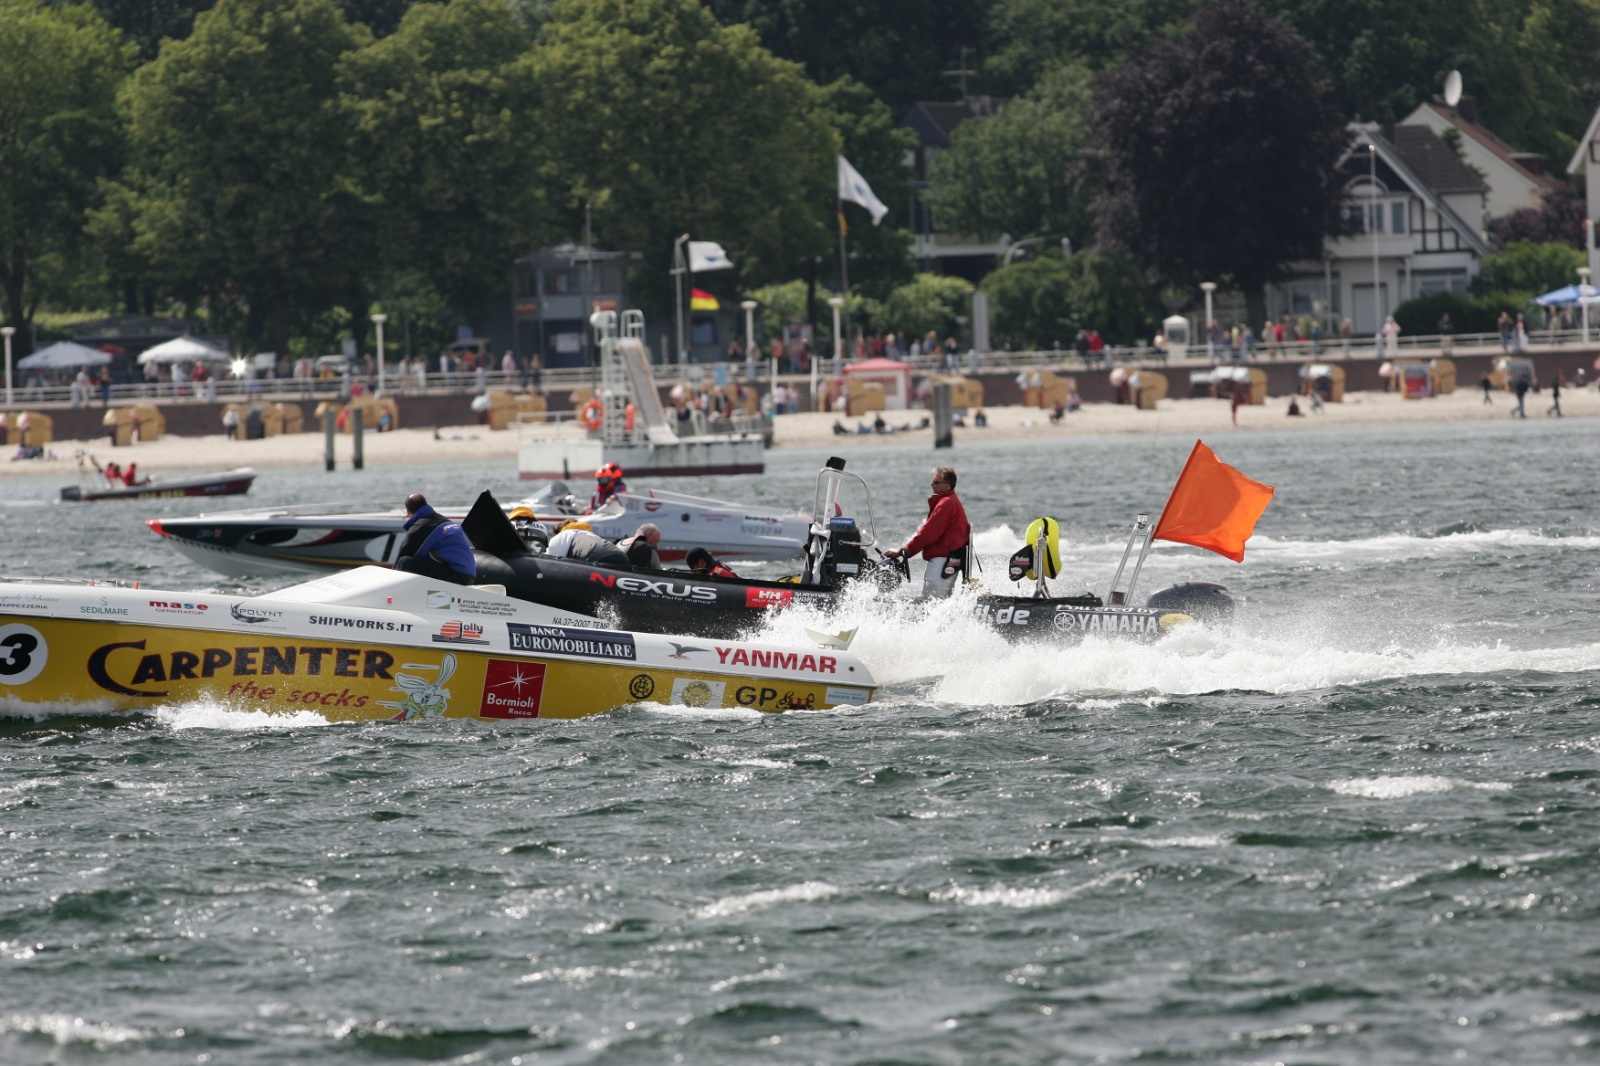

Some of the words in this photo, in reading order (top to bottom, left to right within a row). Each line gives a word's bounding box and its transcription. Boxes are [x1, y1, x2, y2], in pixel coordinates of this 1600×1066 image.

[588, 571, 718, 601] NEXUS
[80, 605, 129, 616] SEDILMARE
[148, 600, 209, 611] mase
[155, 608, 204, 616] GENERATOR
[239, 607, 284, 618] POLYNT
[1055, 604, 1134, 613] Powered
[1137, 606, 1160, 616] by
[308, 615, 414, 633] SHIPWORKS.IT
[529, 626, 566, 638] BANCA
[1077, 613, 1159, 634] YAMAHA
[0, 632, 38, 676] 3
[511, 632, 634, 658] EUROMOBILIARE
[87, 638, 395, 697] CARPENTER
[714, 646, 838, 674] YANMAR
[227, 680, 276, 701] the
[286, 687, 370, 709] socks
[486, 692, 535, 709] Bormioli
[735, 685, 778, 707] GP
